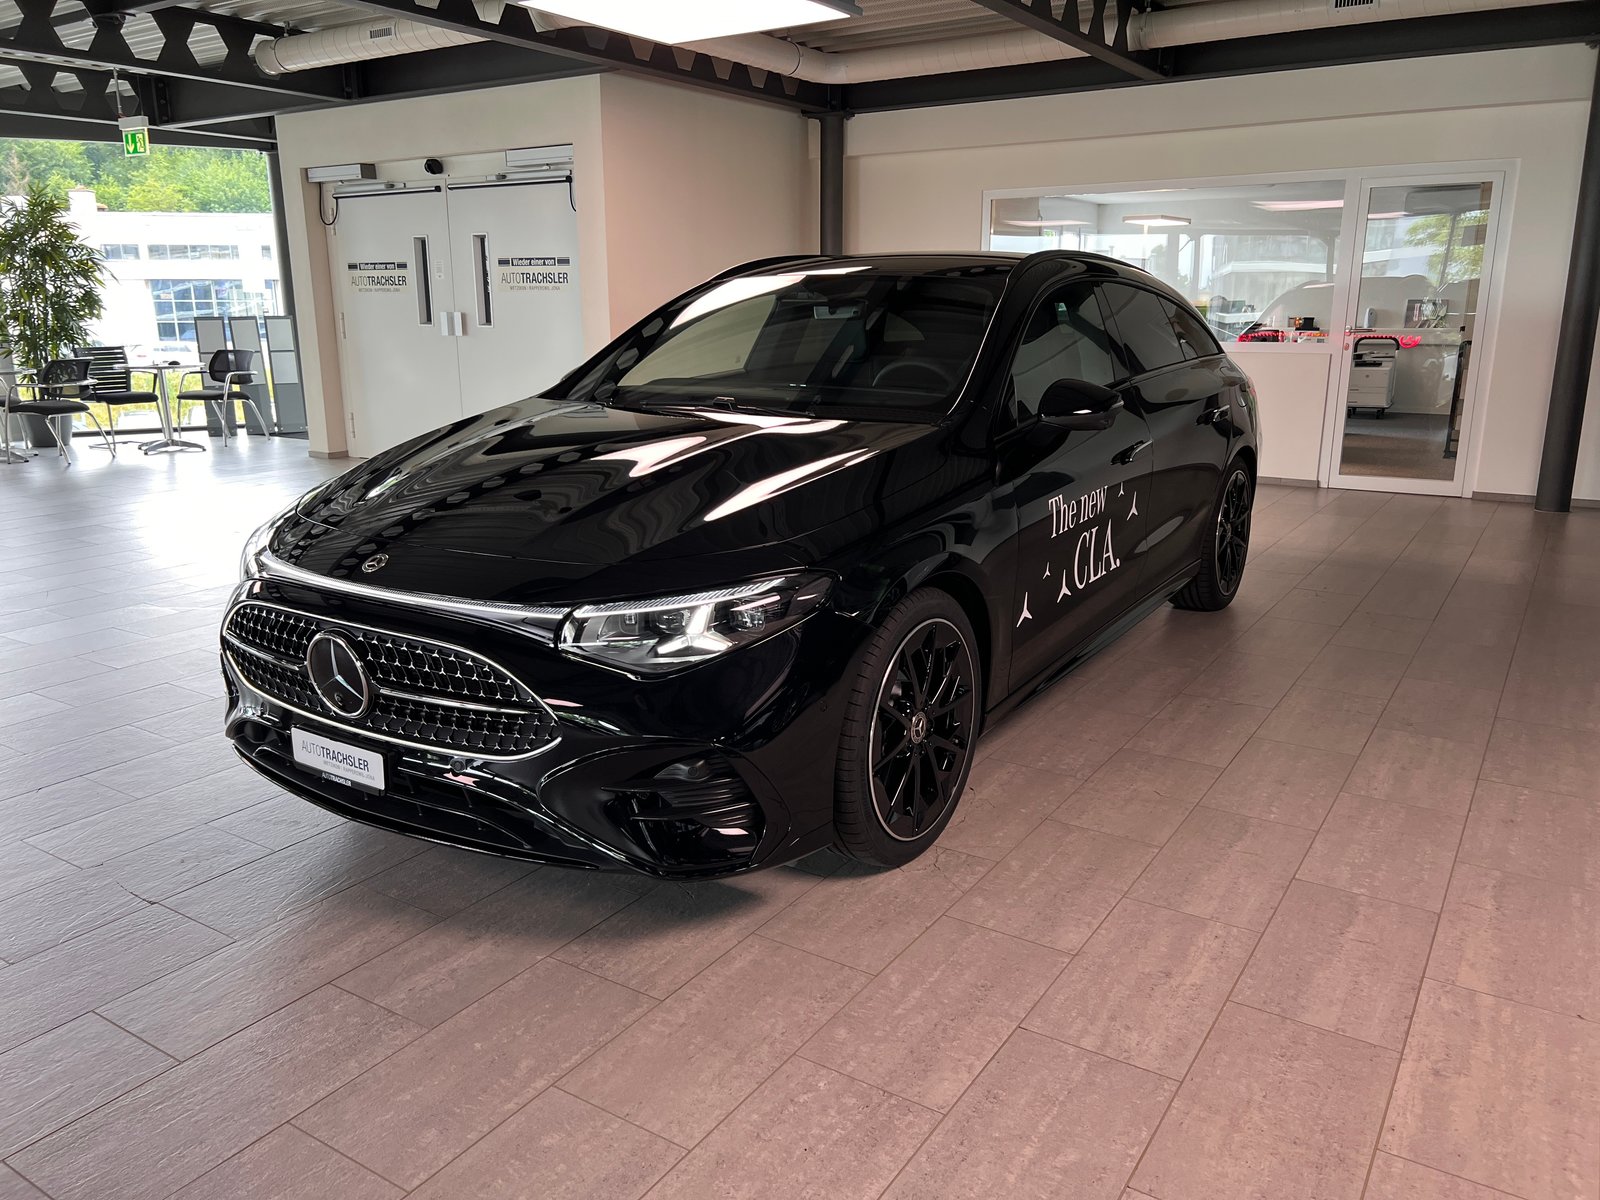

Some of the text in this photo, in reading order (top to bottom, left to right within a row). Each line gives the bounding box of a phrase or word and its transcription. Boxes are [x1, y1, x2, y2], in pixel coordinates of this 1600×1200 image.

[512, 258, 530, 266] Wieder
[531, 257, 544, 266] einer
[351, 275, 407, 287] AUTOTRACHSLER
[501, 272, 569, 284] AUTOTRACHSLER
[1048, 485, 1108, 539] The new
[1073, 518, 1121, 590] CLA.
[301, 739, 370, 772] AUTOTRACHSLER
